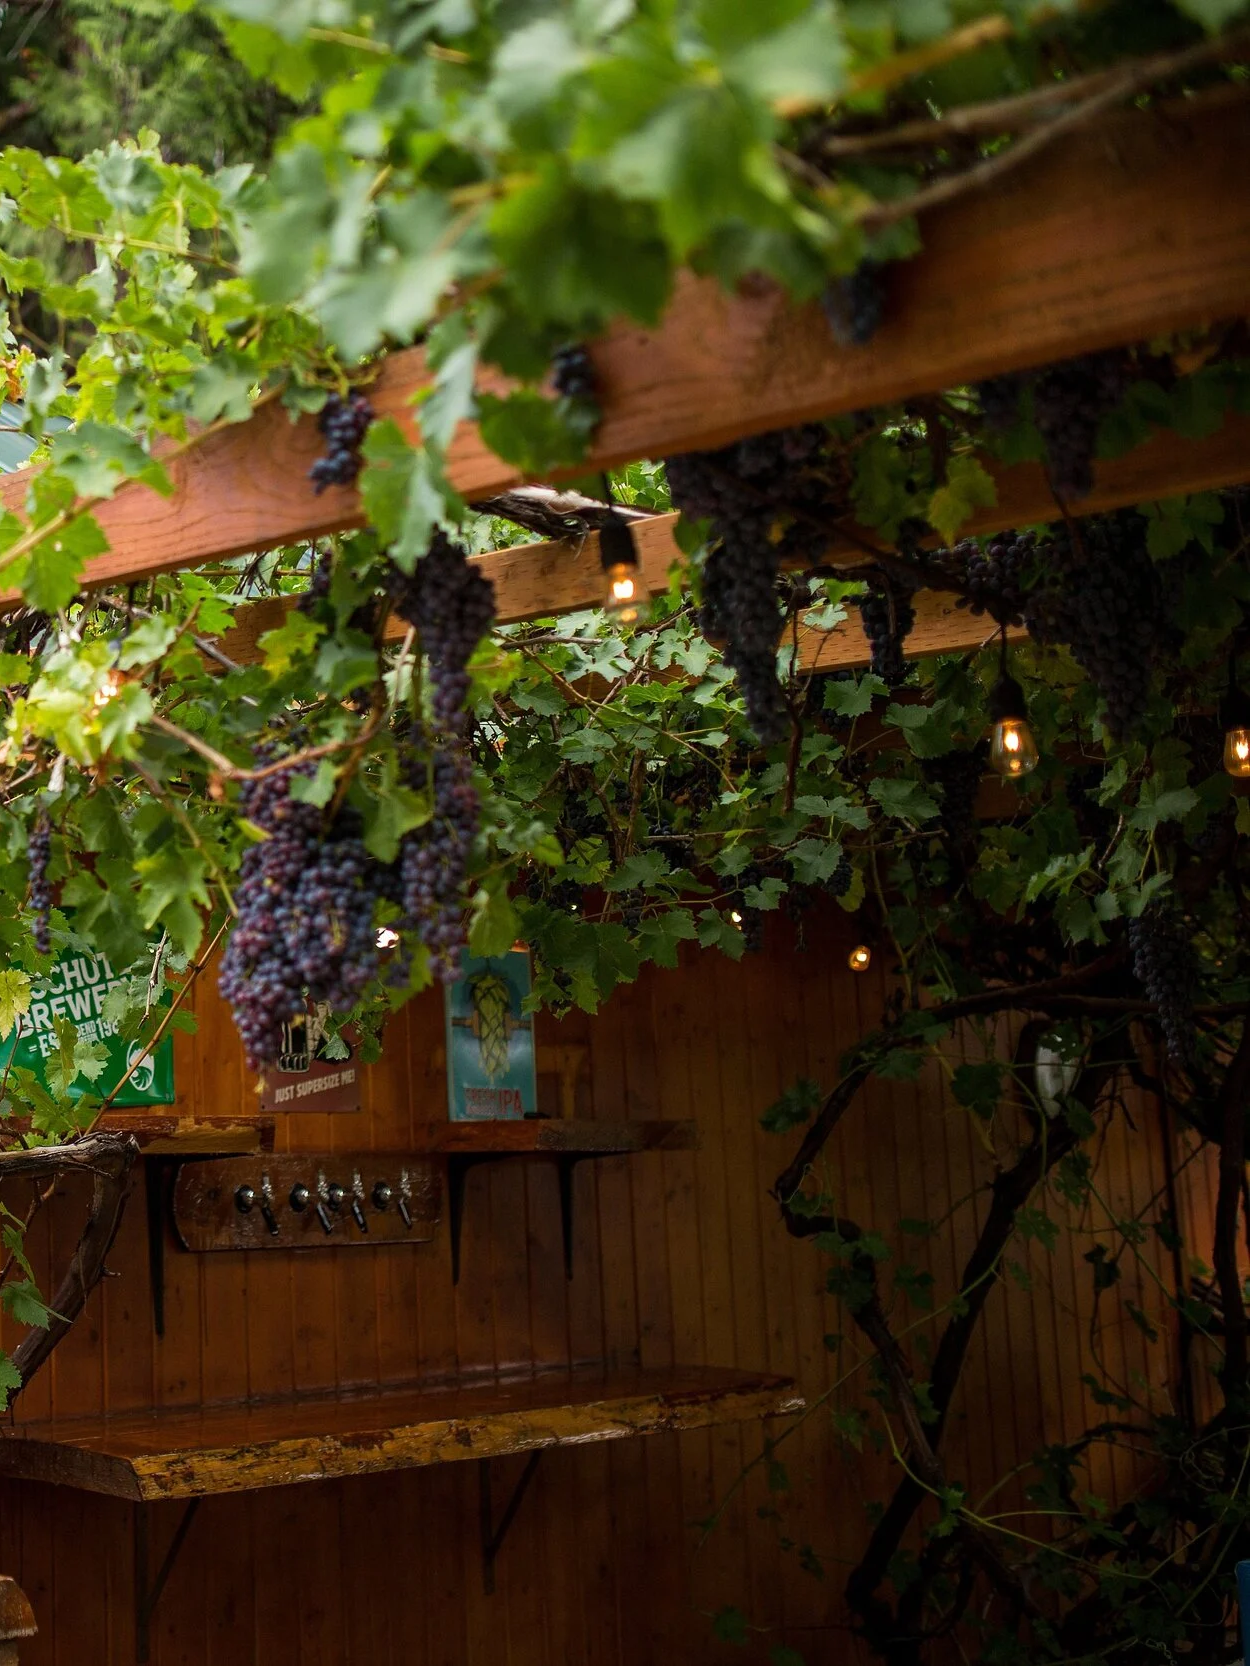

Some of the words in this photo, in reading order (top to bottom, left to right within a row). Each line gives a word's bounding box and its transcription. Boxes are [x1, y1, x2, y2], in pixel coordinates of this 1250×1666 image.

[274, 1085, 295, 1105] JUST
[296, 1072, 340, 1098] SUPERSIZE
[341, 1068, 356, 1087] ME!
